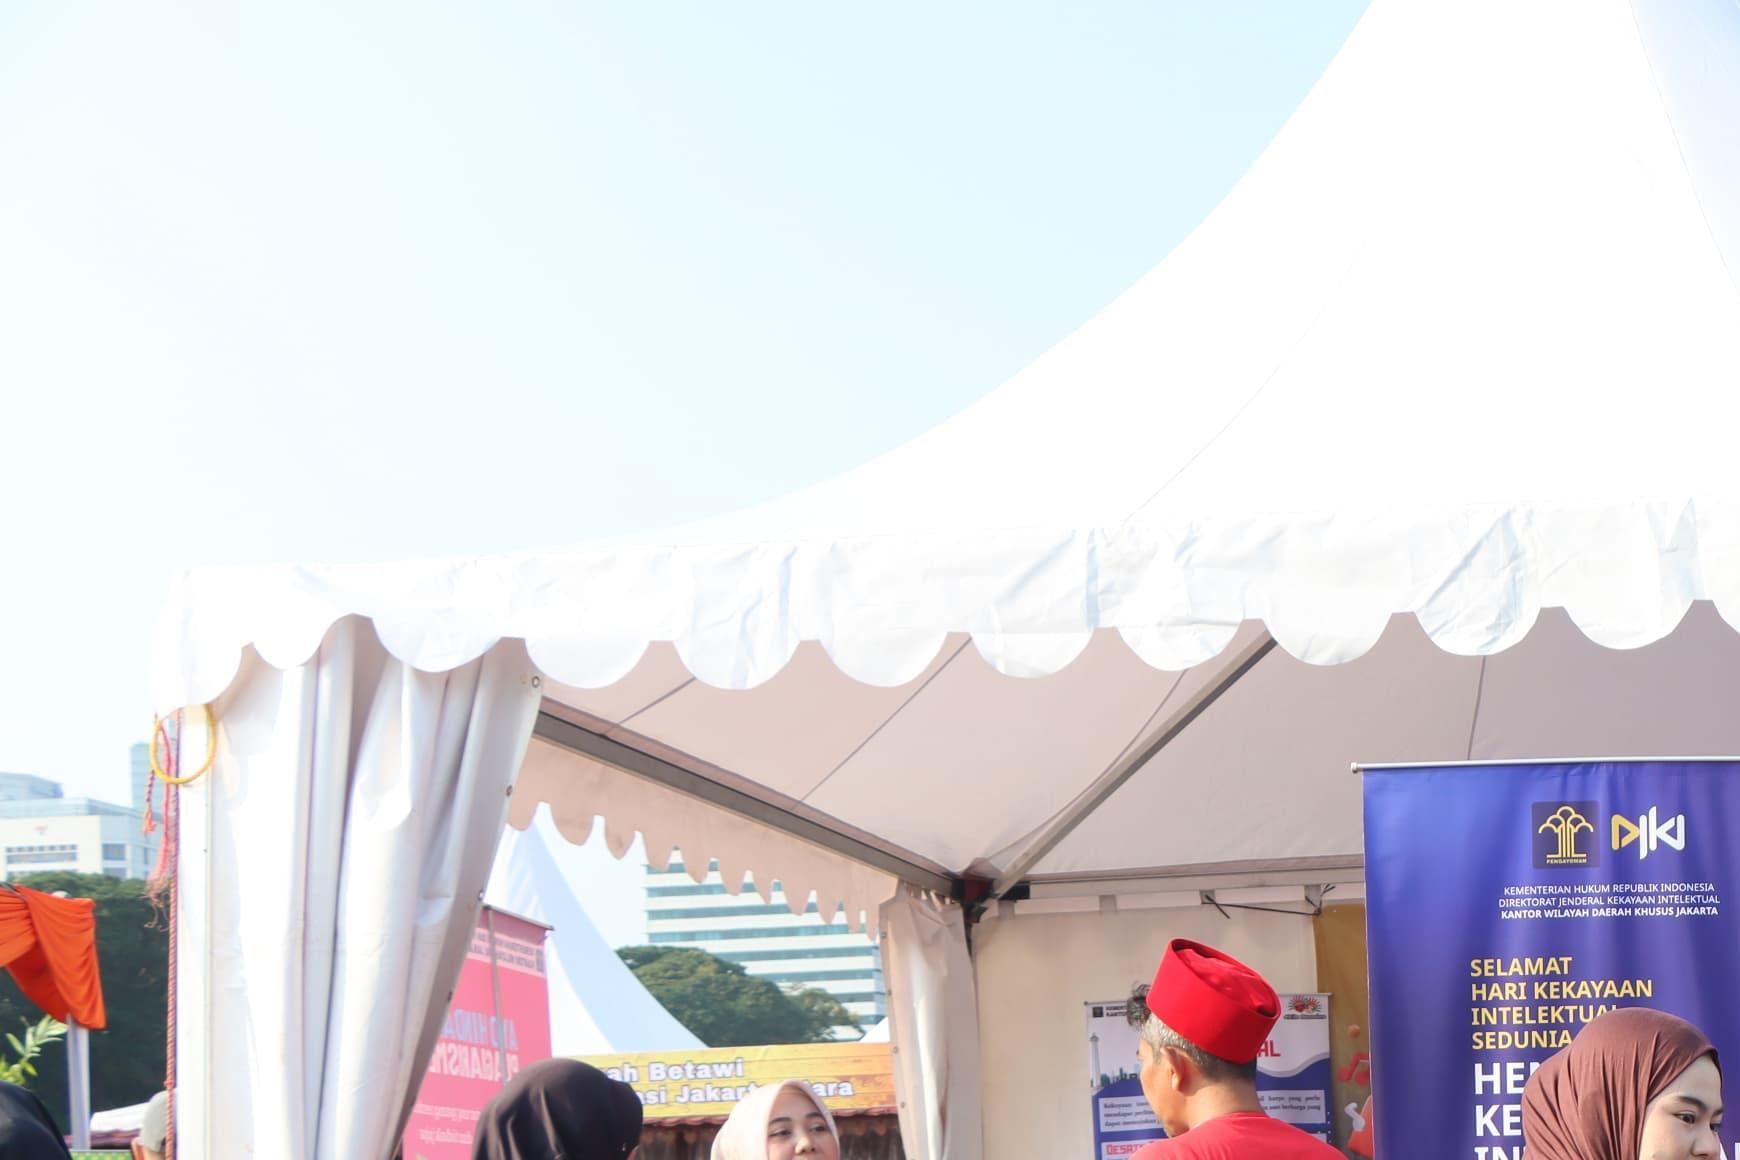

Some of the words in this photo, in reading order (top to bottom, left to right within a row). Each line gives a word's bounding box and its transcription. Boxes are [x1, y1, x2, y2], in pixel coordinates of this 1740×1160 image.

[1504, 885, 1571, 896] KEMENTERIAN
[1573, 884, 1610, 894] HUKUM
[1613, 884, 1658, 893] REPUBLIK
[1661, 883, 1715, 892] INDONESIA
[1499, 897, 1556, 907] DIREKTORAT
[1558, 897, 1605, 907] JENDERAL
[1607, 896, 1656, 905] KEKAYAAN
[1658, 895, 1721, 904] INTELEKTUAL
[1501, 910, 1542, 920] KANTOR
[1543, 908, 1590, 918] WILAYAH
[1591, 908, 1632, 917] DAERAH
[1634, 907, 1674, 916] KHUSUS
[1675, 906, 1719, 917] JAKARTA
[1470, 956, 1573, 977] SELAMAT
[1471, 982, 1527, 1000] HARI
[1534, 979, 1653, 999] KEKAYAAN
[1471, 1004, 1618, 1026] INTELEKTUA
[1471, 1029, 1573, 1050] SEDUNIA
[606, 1062, 640, 1083] ah
[648, 1056, 744, 1082] Betawi
[810, 1081, 854, 1098] ara
[1475, 1104, 1522, 1137] KE
